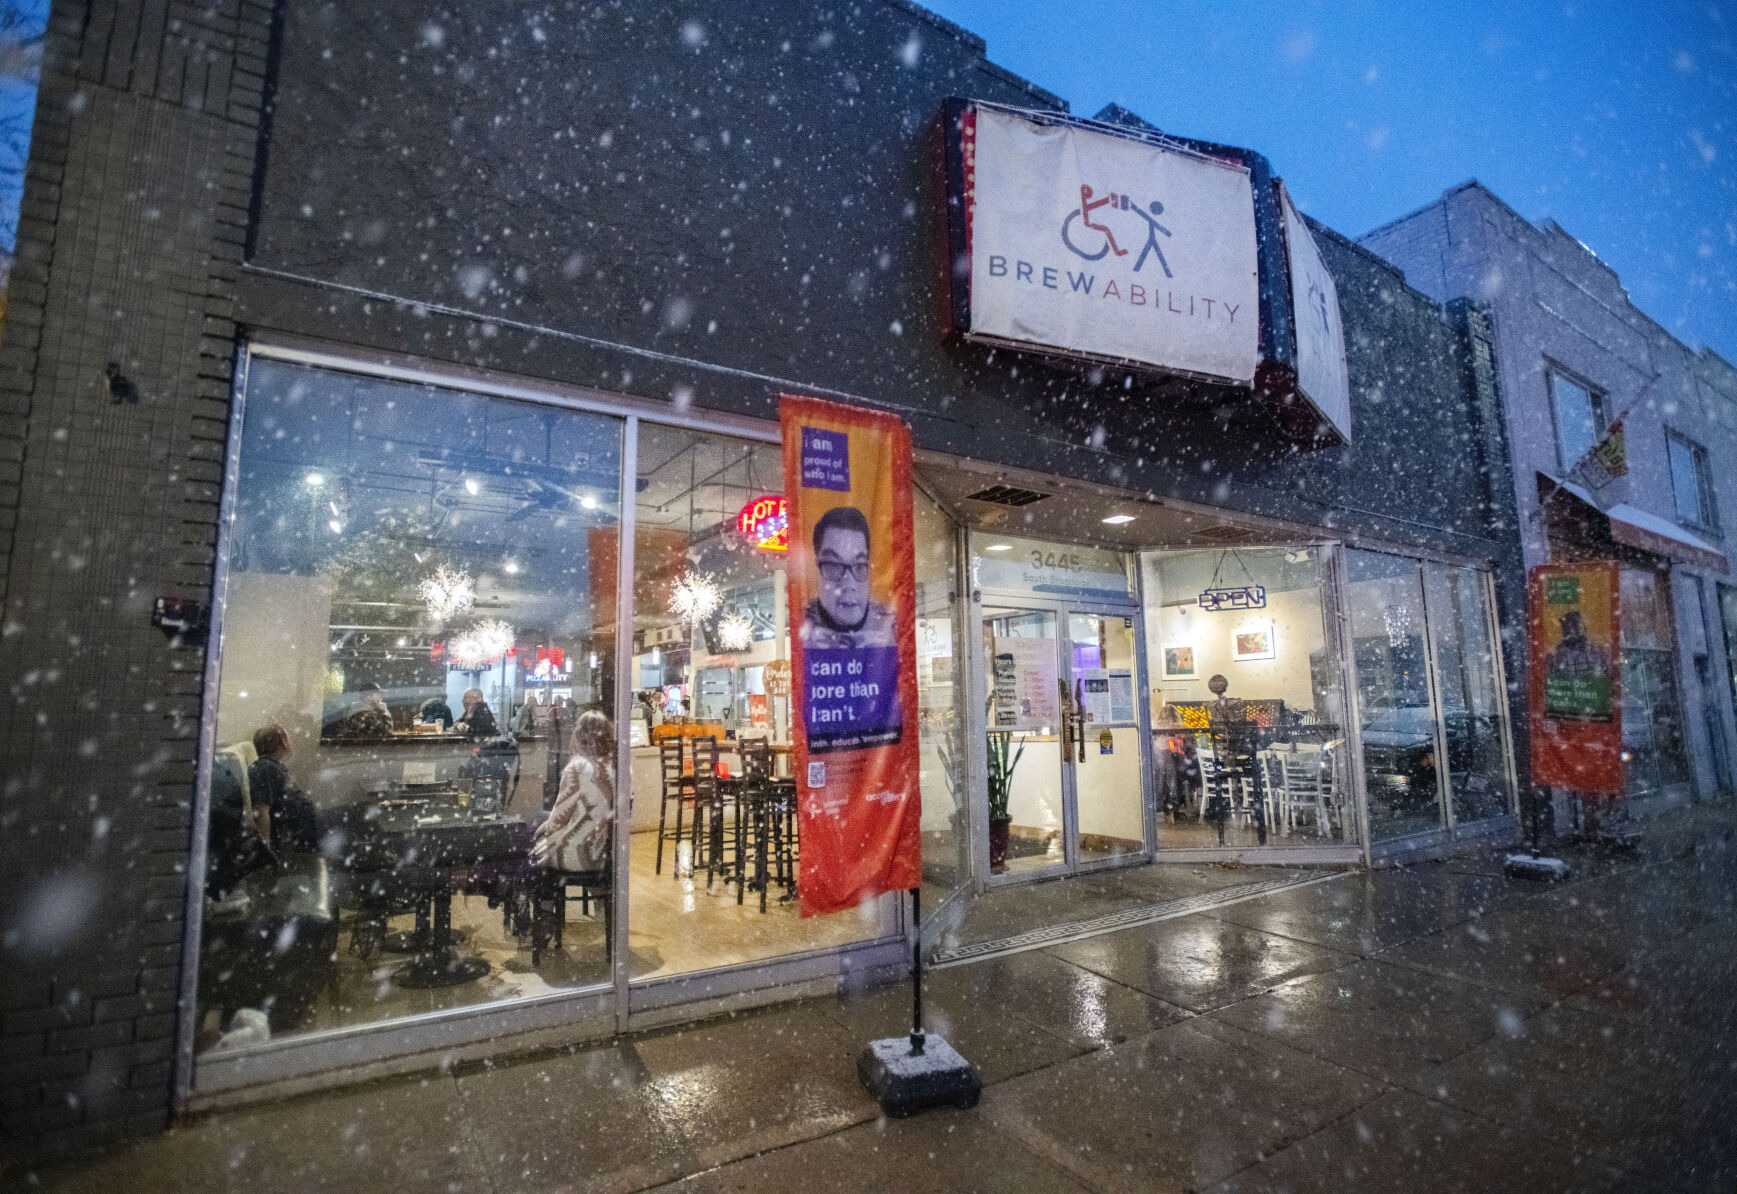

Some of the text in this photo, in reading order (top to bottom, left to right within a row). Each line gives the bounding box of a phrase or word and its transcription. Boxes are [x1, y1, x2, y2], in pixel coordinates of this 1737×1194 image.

[988, 255, 1240, 324] BREWABILITY
[812, 439, 833, 451] am
[742, 500, 777, 533] HOT
[1031, 550, 1082, 574] 3445
[811, 659, 863, 675] can do
